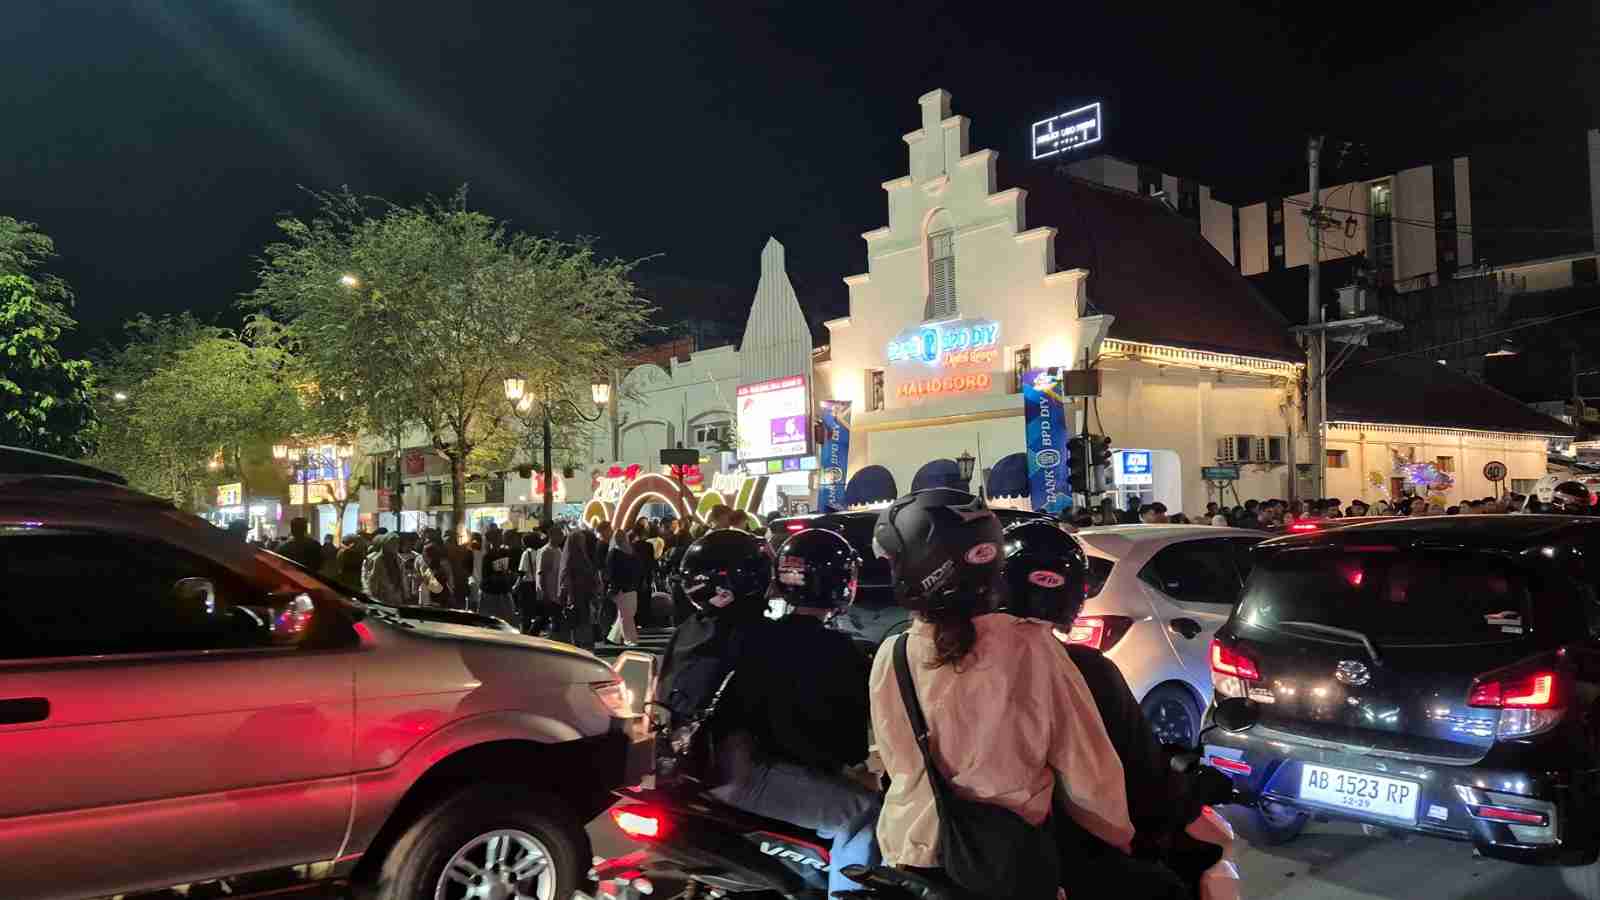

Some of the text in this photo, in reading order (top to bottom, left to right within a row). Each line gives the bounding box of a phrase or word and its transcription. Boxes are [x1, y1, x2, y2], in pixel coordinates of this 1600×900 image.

[1040, 397, 1050, 417] DIY
[1041, 421, 1052, 446] BPD
[1308, 769, 1410, 804] AB 1523 RP
[760, 841, 830, 872] VAR
